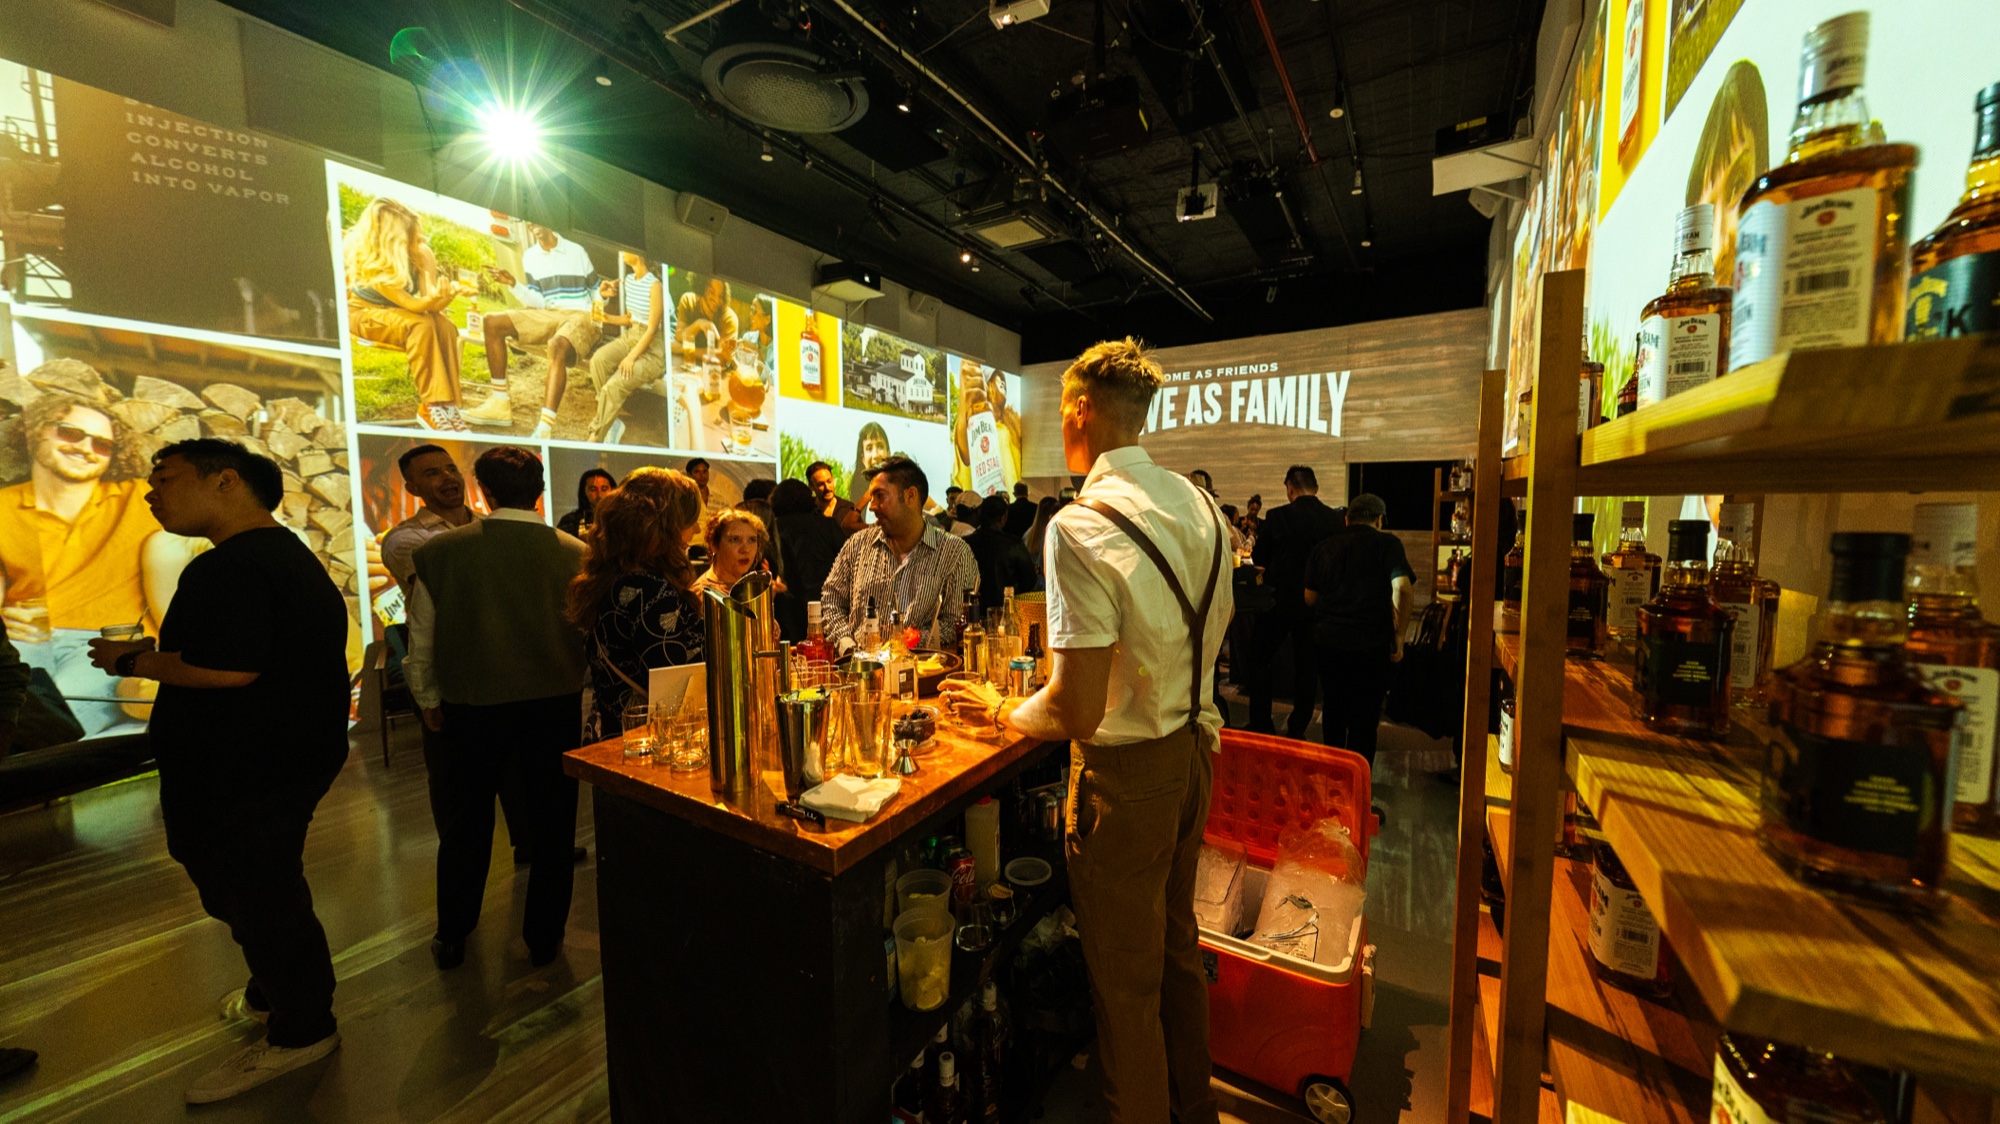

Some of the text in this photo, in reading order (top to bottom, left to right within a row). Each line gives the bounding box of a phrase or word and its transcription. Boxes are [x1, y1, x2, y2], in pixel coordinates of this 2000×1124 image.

[125, 111, 269, 149] INJECTION
[125, 131, 269, 166] CONVERTS
[130, 151, 254, 181] ALCOHOL
[132, 170, 290, 205] INTO VAPOR
[1690, 317, 1707, 326] BEAM
[1195, 369, 1213, 379] AS
[1217, 362, 1279, 377] FRIENDS
[1184, 382, 1222, 426] AS
[1230, 370, 1351, 437] FAMILY
[980, 420, 993, 434] BEA
